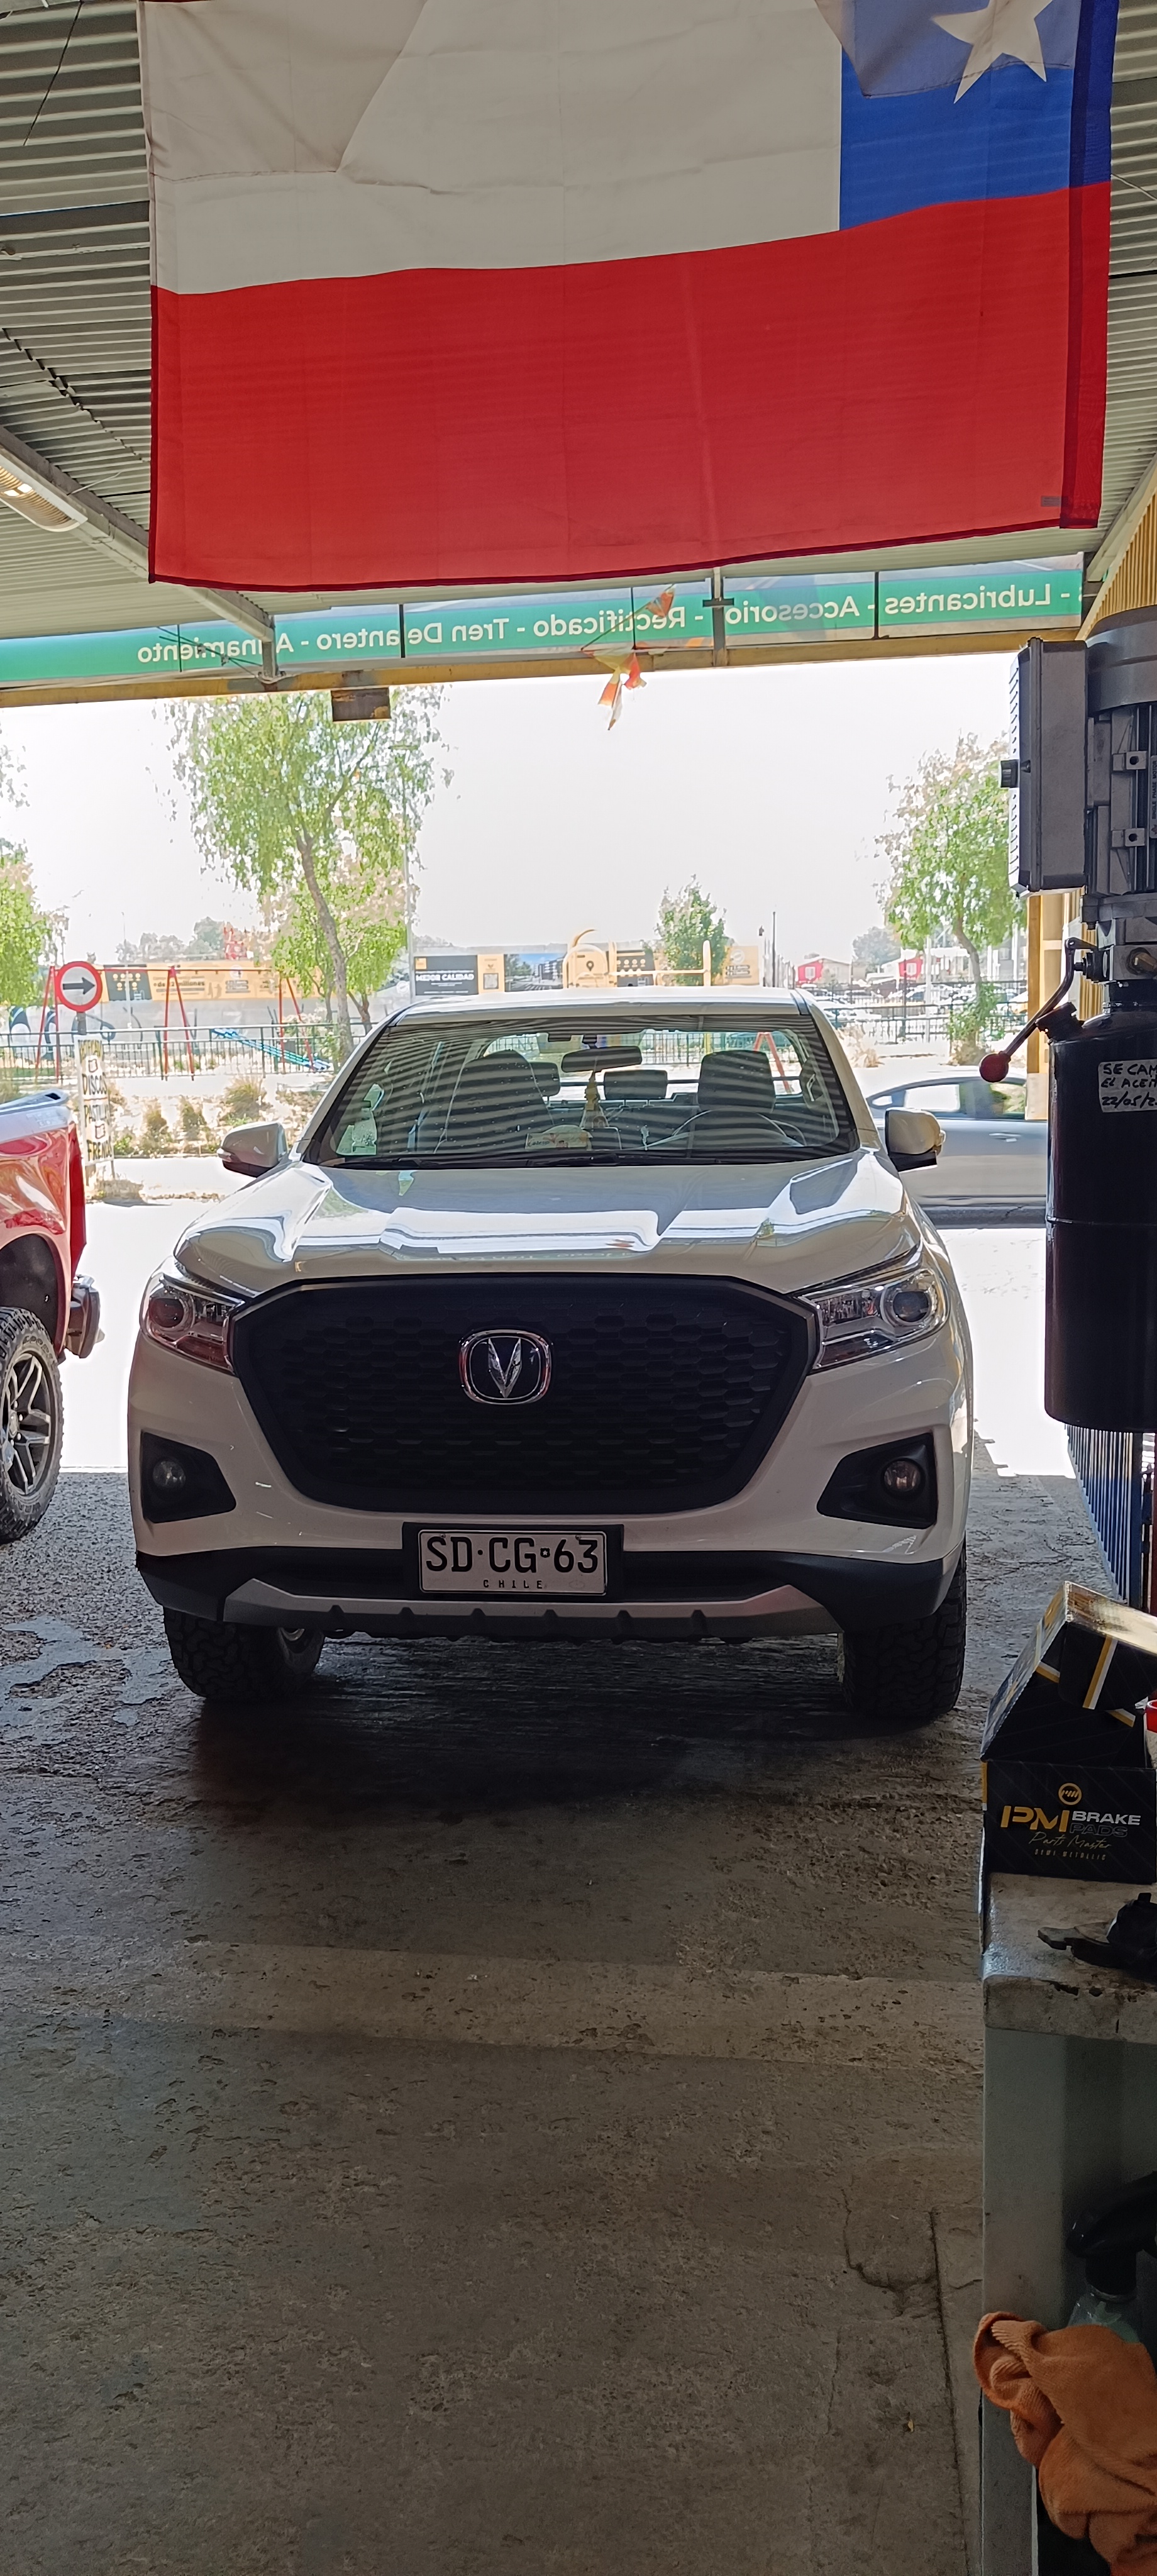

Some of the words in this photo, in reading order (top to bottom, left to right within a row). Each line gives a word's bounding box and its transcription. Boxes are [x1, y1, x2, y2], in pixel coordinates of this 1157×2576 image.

[1103, 1063, 1124, 1075] SE
[1101, 1091, 1157, 1108] 22/05/2
[482, 1579, 544, 1589] CHILE
[1000, 1805, 1070, 1833] PM
[1071, 1810, 1142, 1826] BRAKE
[1070, 1822, 1128, 1838] PADS
[1028, 1831, 1066, 1847] Parts
[1068, 1834, 1112, 1850] Master
